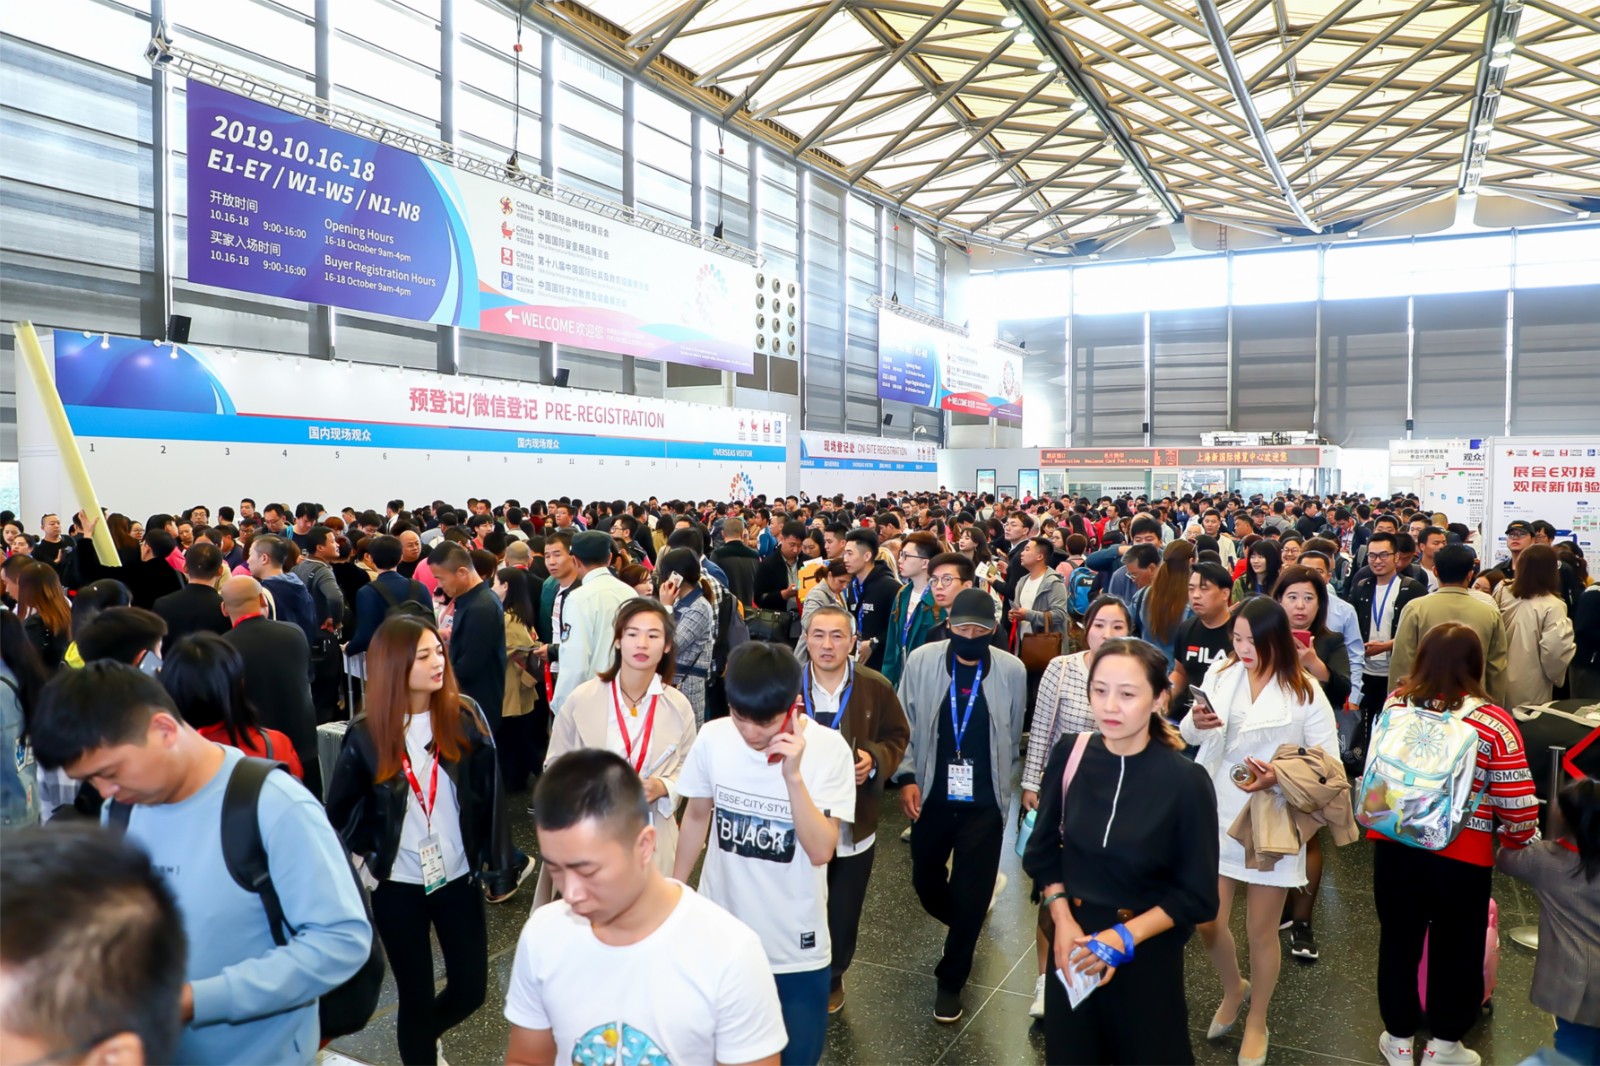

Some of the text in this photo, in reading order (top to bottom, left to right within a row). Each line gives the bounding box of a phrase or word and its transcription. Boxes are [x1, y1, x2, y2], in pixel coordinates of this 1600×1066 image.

[210, 114, 376, 182] 2019.10.16-18
[207, 148, 420, 222] E1-E7 / W1-W5 / N1-N8
[210, 190, 258, 214] 开放时间
[516, 201, 534, 212] CHINA
[210, 209, 306, 239] 10.16-18 9:00-16:00
[324, 218, 394, 244] Opening Hours
[516, 226, 534, 236] CHINA
[538, 208, 610, 238] 中国国际品牌授权展览会
[210, 230, 281, 256] 买家入场时间
[324, 236, 412, 262] 16-18 October 9am-4pm
[538, 232, 610, 260] 中国国际婴童用品展览会
[210, 250, 306, 276] 10.16-18 9:00-16:00
[516, 251, 534, 261] CHINA
[324, 254, 436, 287] Buyer Registration Hours
[324, 272, 412, 297] 16-18 October 9am-4pm
[521, 311, 576, 334] WELCOME
[576, 322, 605, 340] 欢迎您
[408, 386, 665, 430] 预登记/微信登记 PRE-REGISTRATION
[308, 425, 372, 442] 国内现场观众
[516, 436, 560, 450] 国内现场观众
[90, 442, 95, 452] 1
[160, 445, 166, 454] 2
[225, 447, 230, 456] 3
[282, 449, 288, 458] 4
[335, 450, 340, 459] 5
[382, 452, 387, 460] 6
[712, 448, 753, 458] OVERSEAS VISITOR
[824, 440, 855, 454] 现场登记处
[877, 445, 908, 456] REGISTRATION
[1196, 451, 1288, 463] 上海新国际博览中心欢迎您
[1464, 453, 1485, 461] 观众
[1513, 466, 1596, 478] 展会E对接
[1513, 481, 1600, 493] 观展新体验
[1186, 645, 1228, 664] FILA
[718, 791, 792, 815] ESSE-CITY-STYL
[720, 817, 785, 852] BLACK
